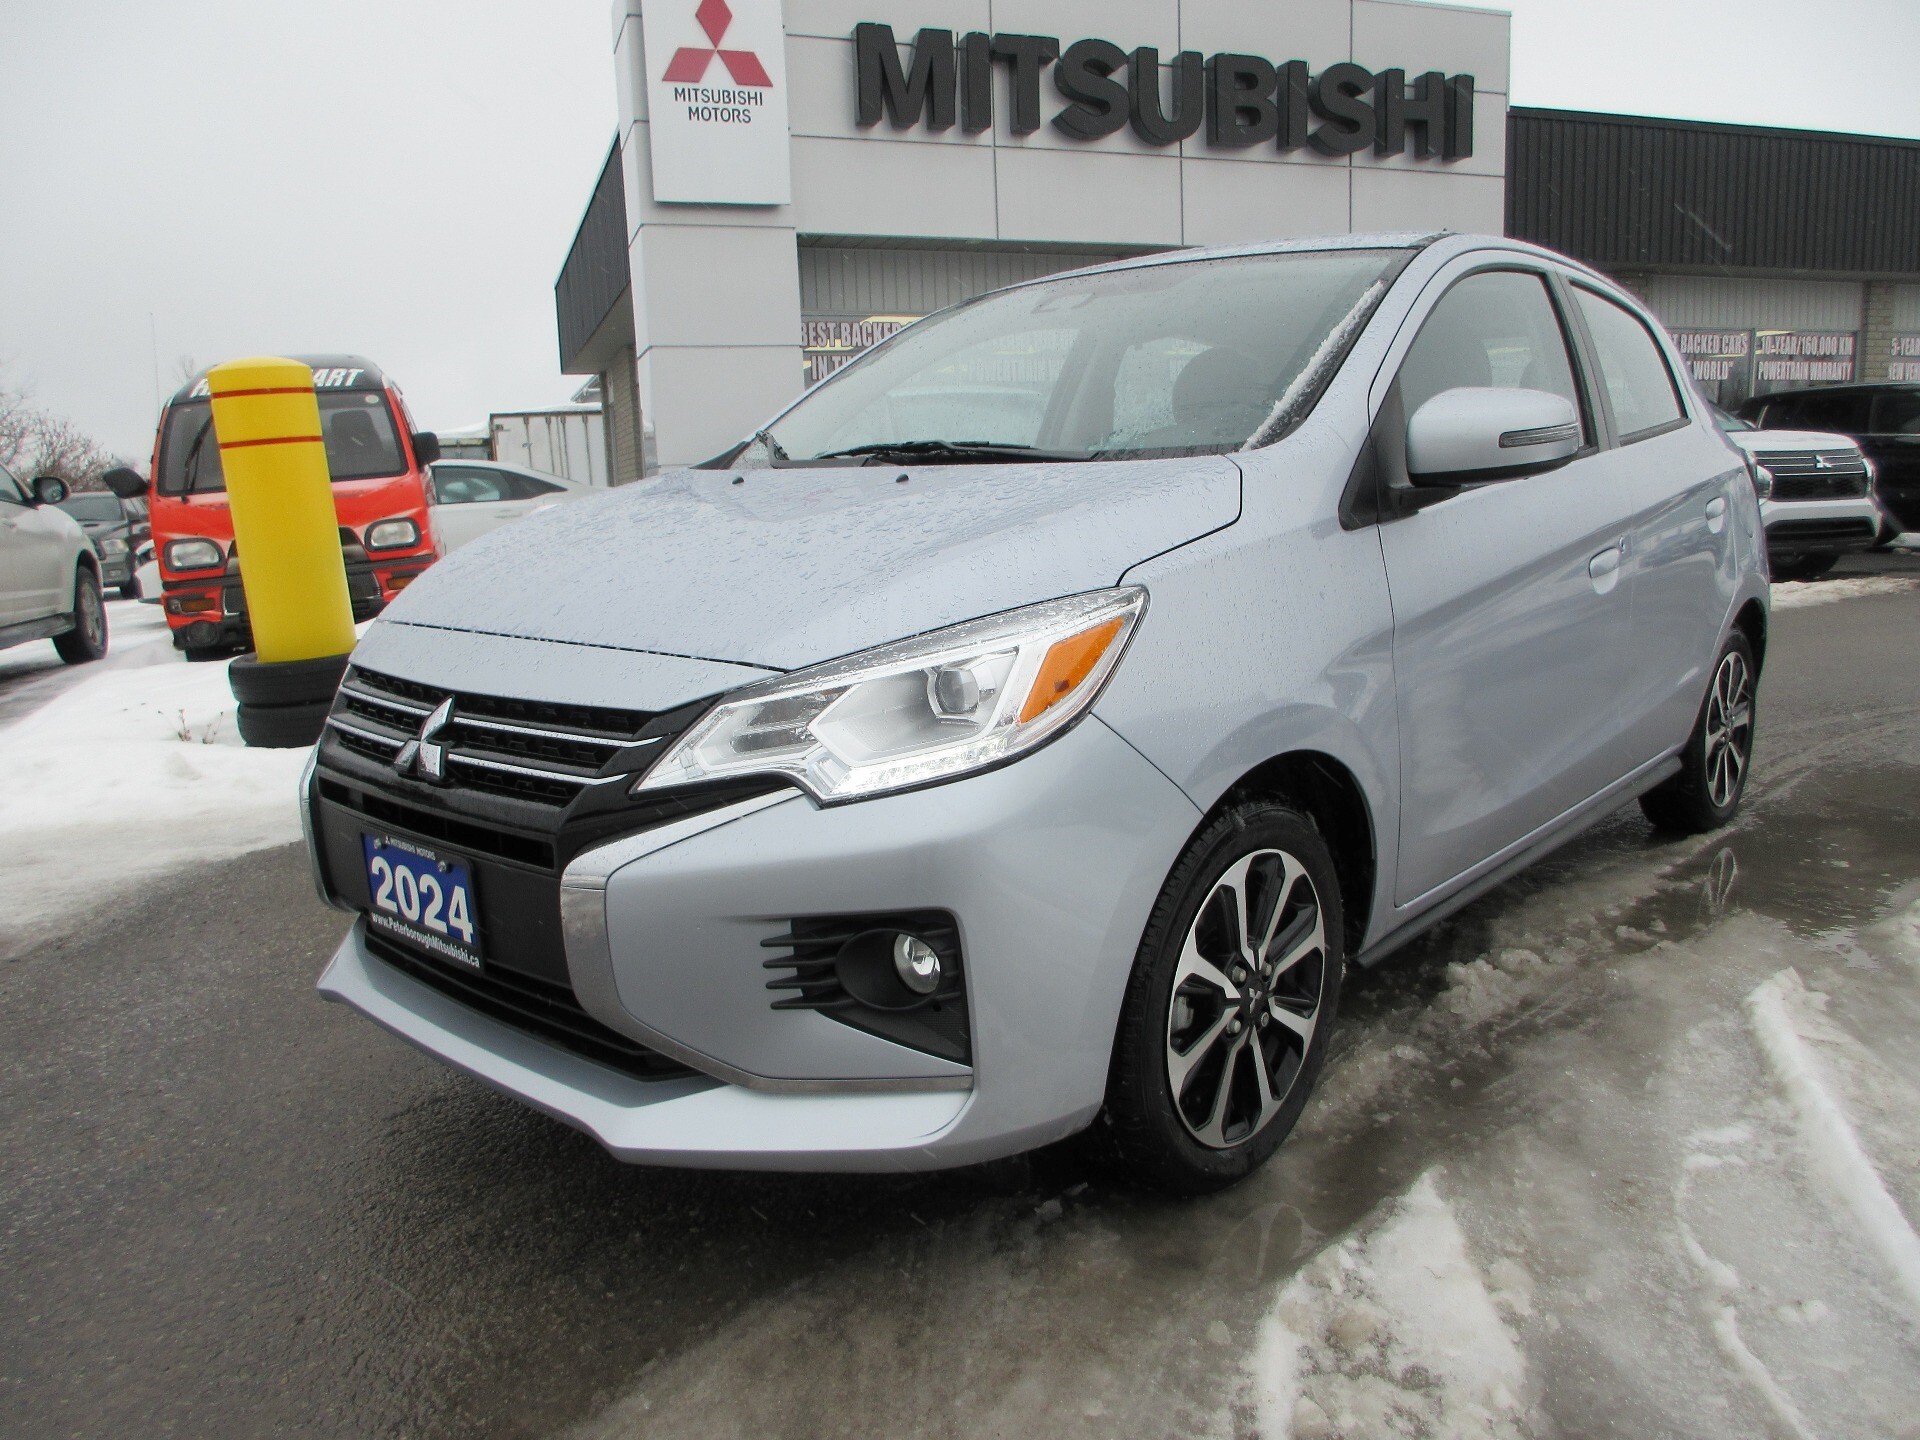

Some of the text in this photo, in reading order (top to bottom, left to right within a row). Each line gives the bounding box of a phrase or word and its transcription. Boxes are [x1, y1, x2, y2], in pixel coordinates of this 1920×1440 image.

[674, 87, 763, 106] MITSUBISHI
[851, 22, 1475, 161] MITSUBISHI
[688, 106, 752, 123] MOTORS
[801, 321, 836, 347] BEST
[1680, 333, 1720, 354] BACKED
[1722, 335, 1748, 354] CARS
[811, 355, 828, 380] IN
[1757, 361, 1854, 381] POWERTRAIN WARRANTY
[371, 855, 474, 944] 2024
[371, 911, 480, 967] www.PeterboroughMitsubishi.ca
